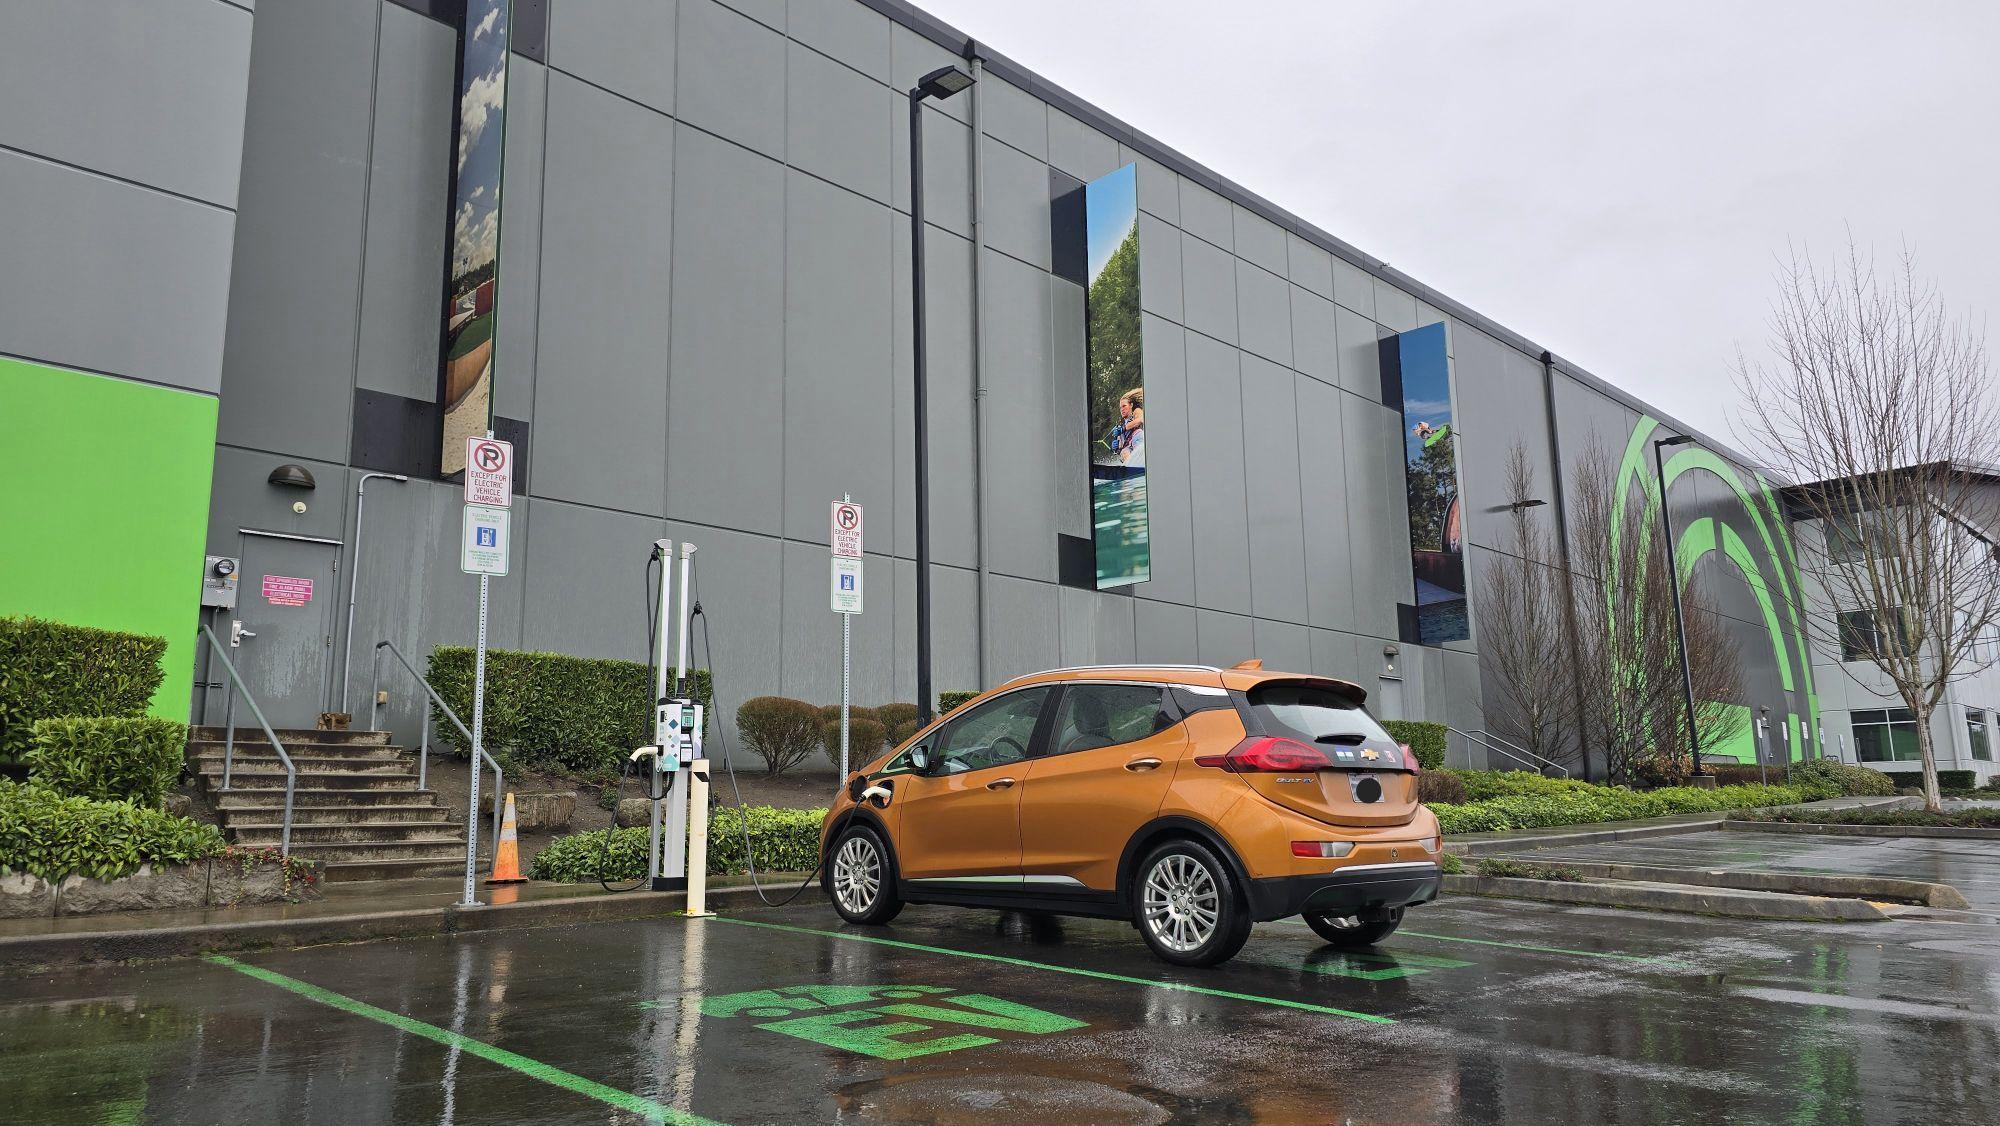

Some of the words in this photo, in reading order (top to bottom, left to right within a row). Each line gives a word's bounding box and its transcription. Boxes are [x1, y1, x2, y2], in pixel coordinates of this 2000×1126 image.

[471, 471, 493, 480] EXCEPT
[495, 474, 507, 482] FOR
[474, 479, 503, 489] ELECTRIC
[476, 487, 501, 496] VEHICLE
[473, 494, 503, 504] CHARGING
[835, 529, 850, 537] EXCEPT
[752, 993, 1092, 1060] EV
